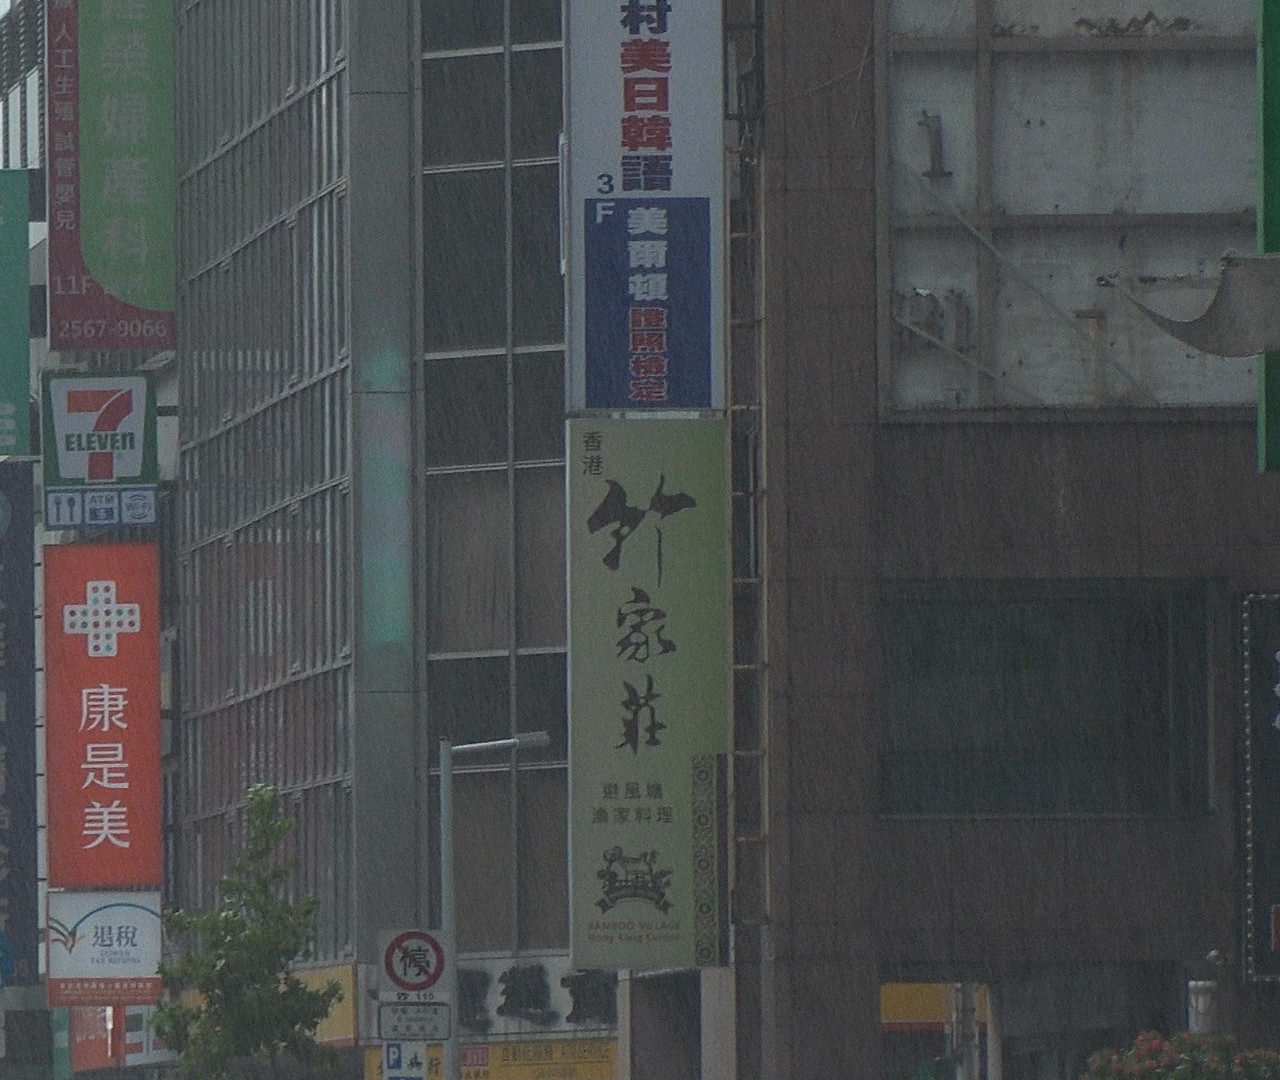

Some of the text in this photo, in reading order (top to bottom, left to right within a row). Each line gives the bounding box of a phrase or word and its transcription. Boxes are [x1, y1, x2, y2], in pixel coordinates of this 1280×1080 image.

[53, 275, 92, 295] 11F
[59, 320, 168, 338] 2567-9066
[67, 389, 133, 480] 7
[581, 431, 603, 477] 香港
[90, 496, 114, 505] ATM
[78, 683, 130, 850] 康是美
[92, 925, 138, 948] 退稅
[399, 945, 431, 980] 停
